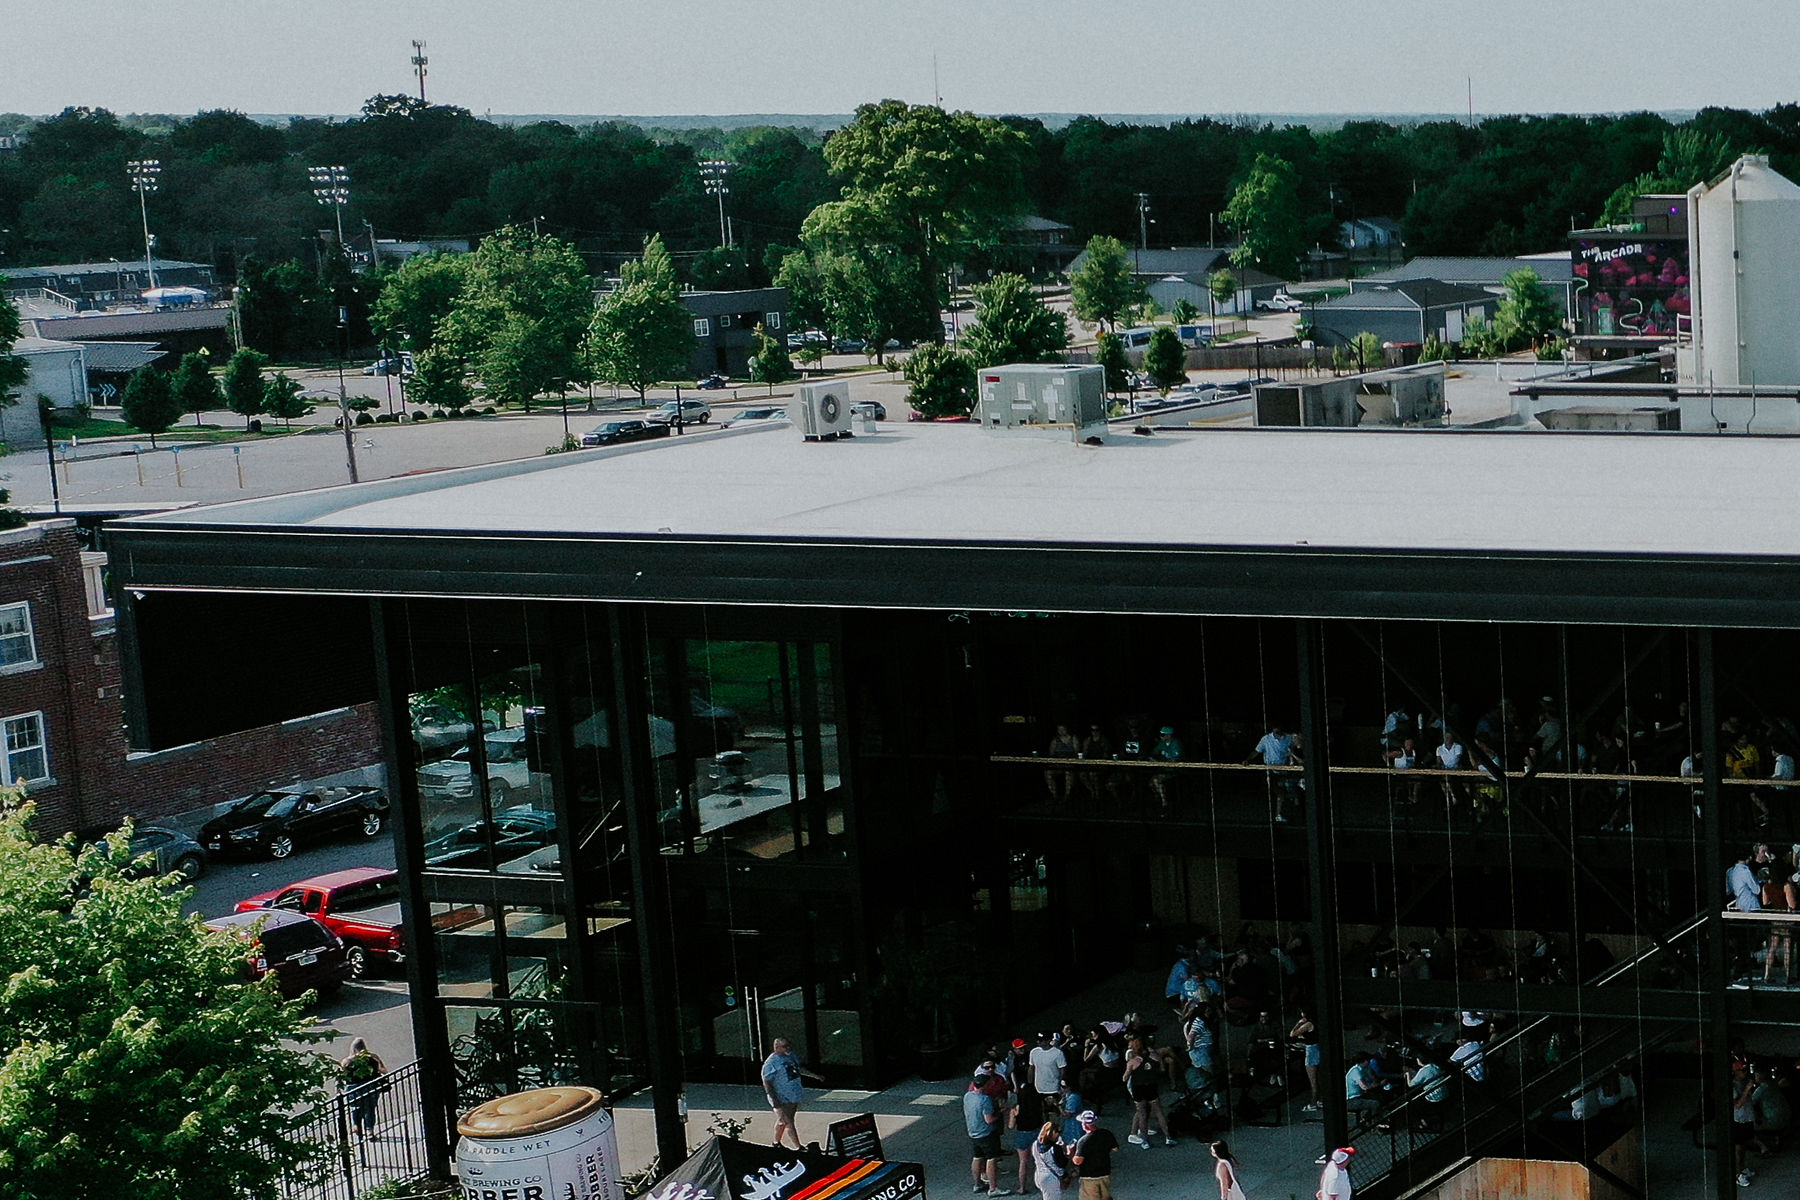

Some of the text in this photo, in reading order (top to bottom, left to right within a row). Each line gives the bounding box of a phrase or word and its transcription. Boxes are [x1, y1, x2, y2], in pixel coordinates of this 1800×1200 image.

[523, 1140, 551, 1152] WET
[473, 1178, 521, 1187] BREWING
[525, 1175, 543, 1184] CO
[898, 1174, 918, 1192] CO.
